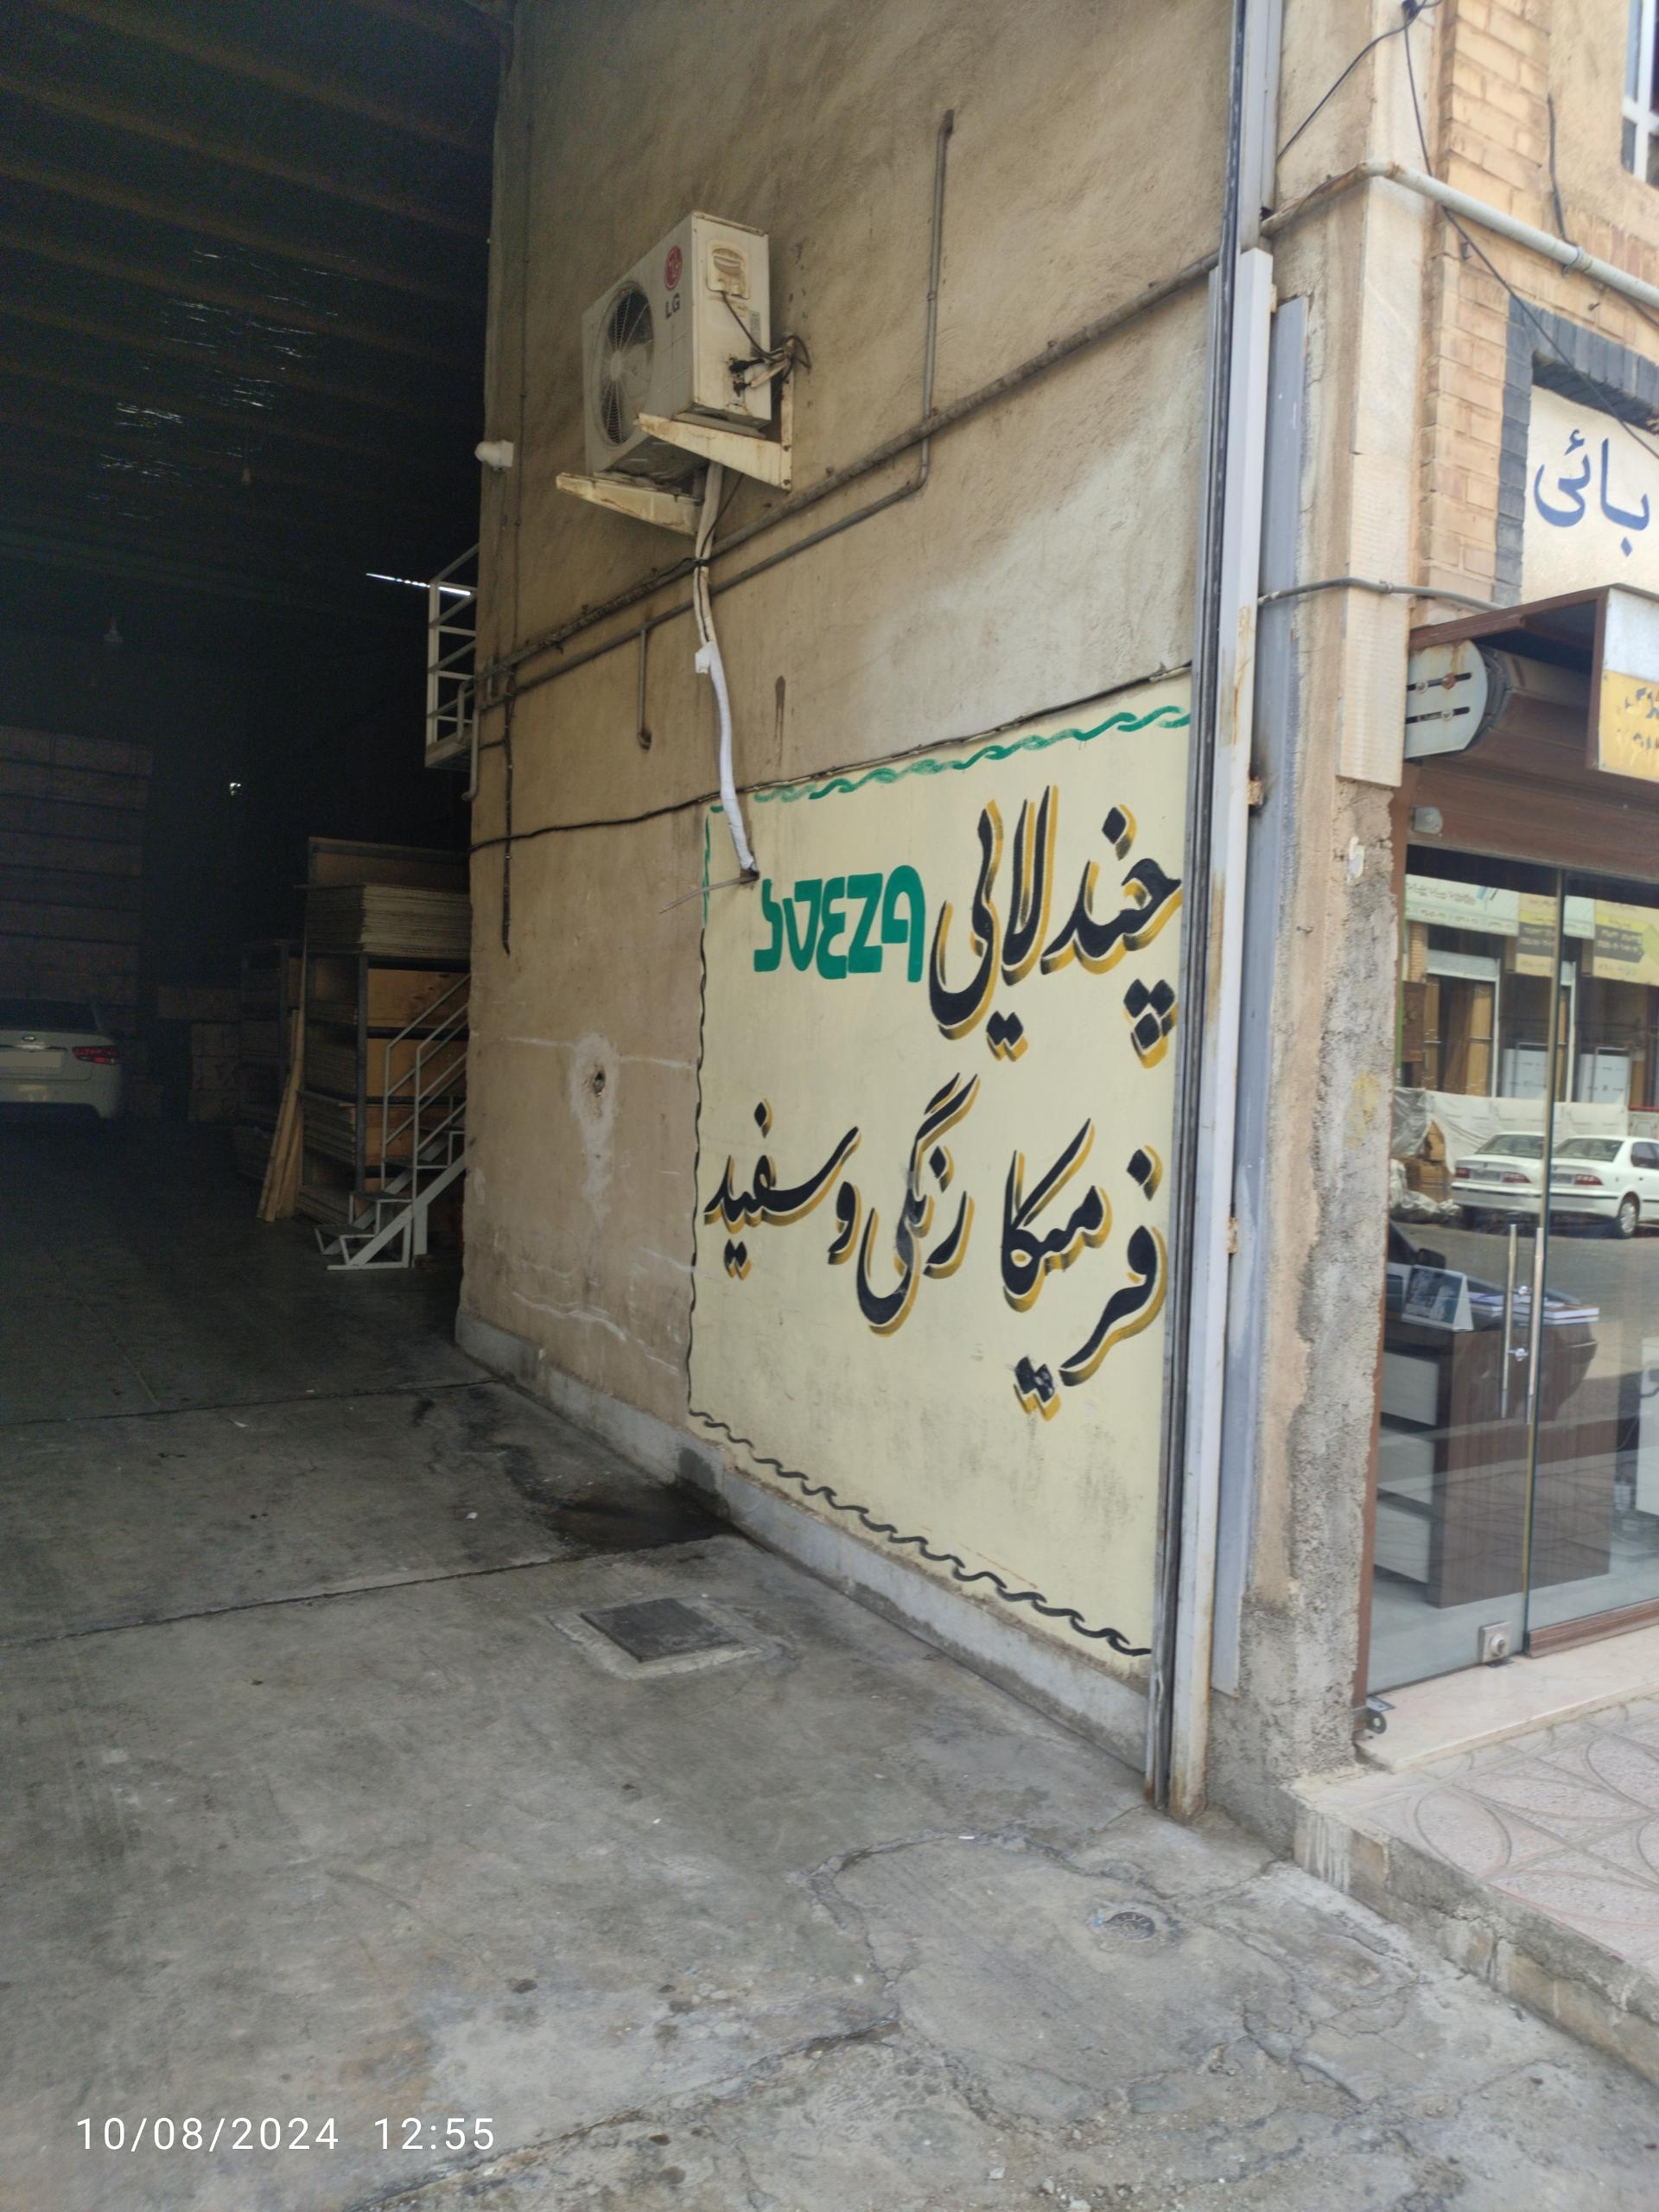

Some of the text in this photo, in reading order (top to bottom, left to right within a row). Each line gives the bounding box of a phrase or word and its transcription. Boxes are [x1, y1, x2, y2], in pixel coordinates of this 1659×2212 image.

[664, 292, 681, 320] LG
[702, 1097, 862, 1281] سفید
[827, 1180, 861, 1266] و
[1000, 1117, 1168, 1421] فرمیکا
